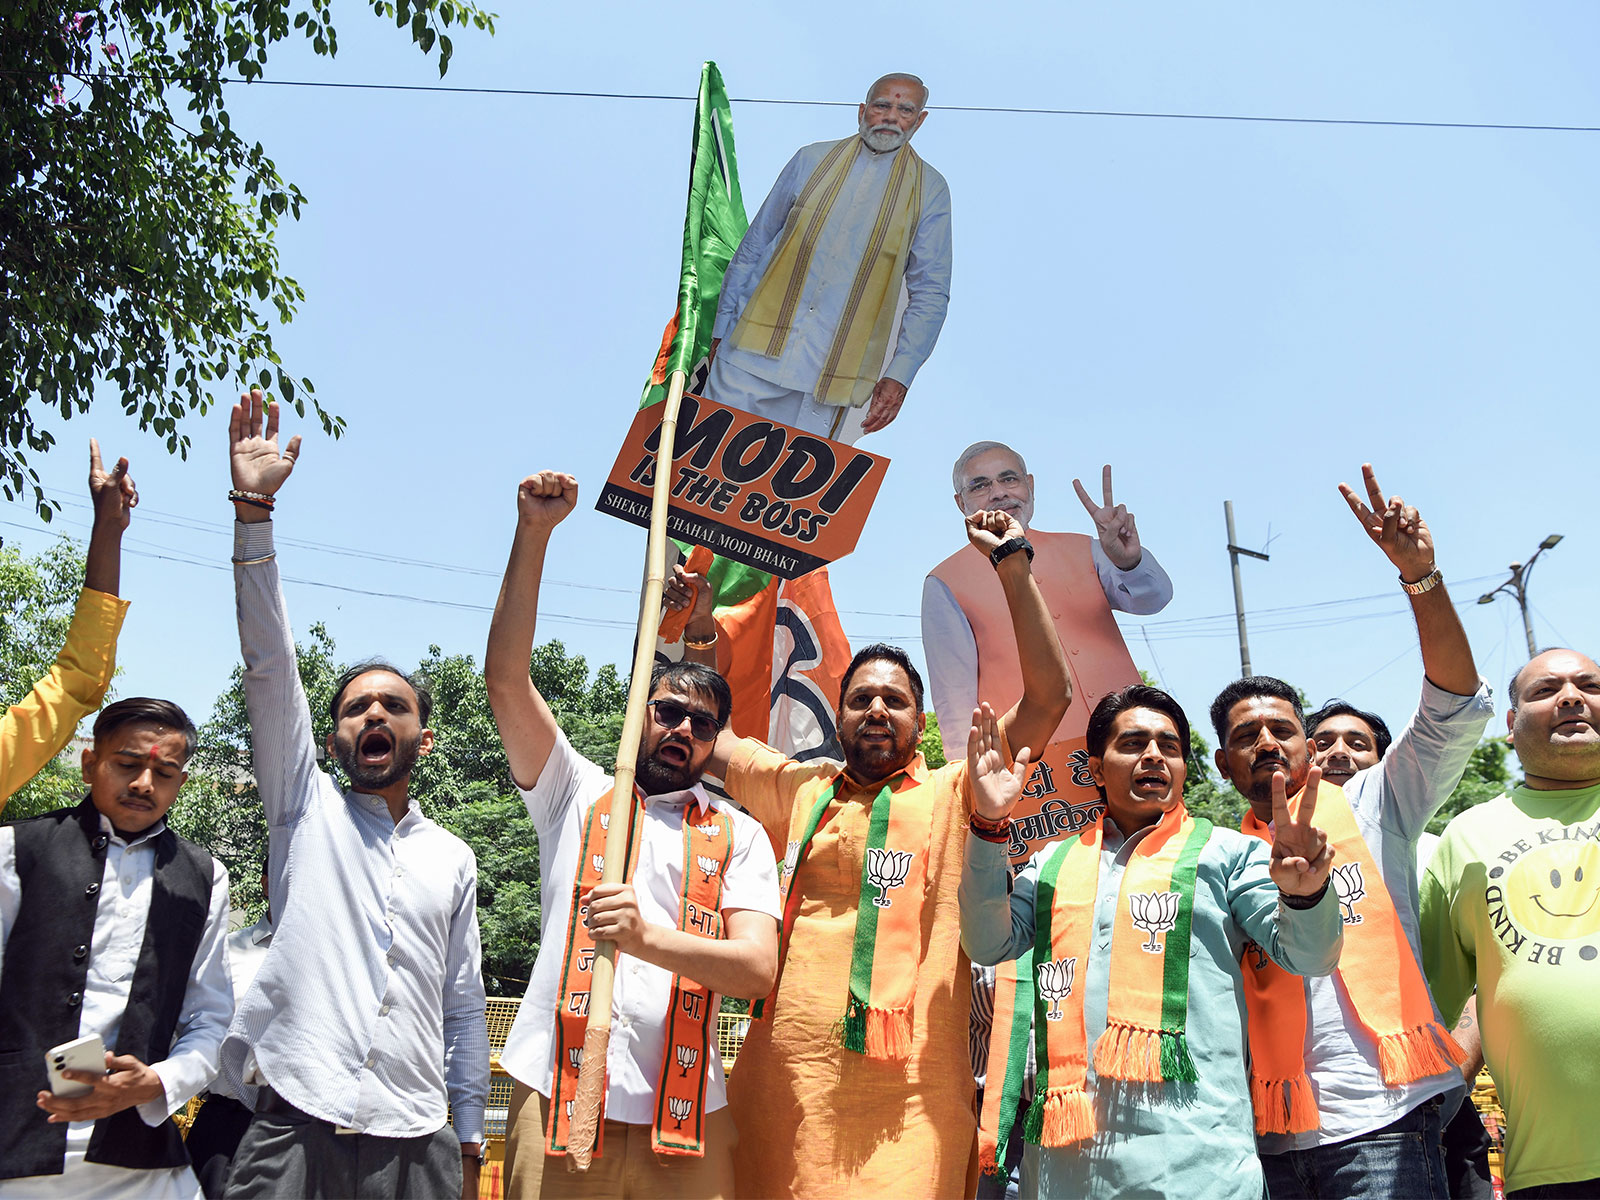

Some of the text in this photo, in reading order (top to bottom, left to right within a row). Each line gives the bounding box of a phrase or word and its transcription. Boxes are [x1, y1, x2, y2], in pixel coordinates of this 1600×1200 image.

[643, 395, 874, 515] MODI
[604, 492, 800, 573] SHEKHA CHAHAL MODI BHAKT
[671, 467, 741, 514] THE
[739, 491, 830, 544] BOSS
[1498, 838, 1533, 865] BE
[1485, 884, 1566, 967] BE KIND
